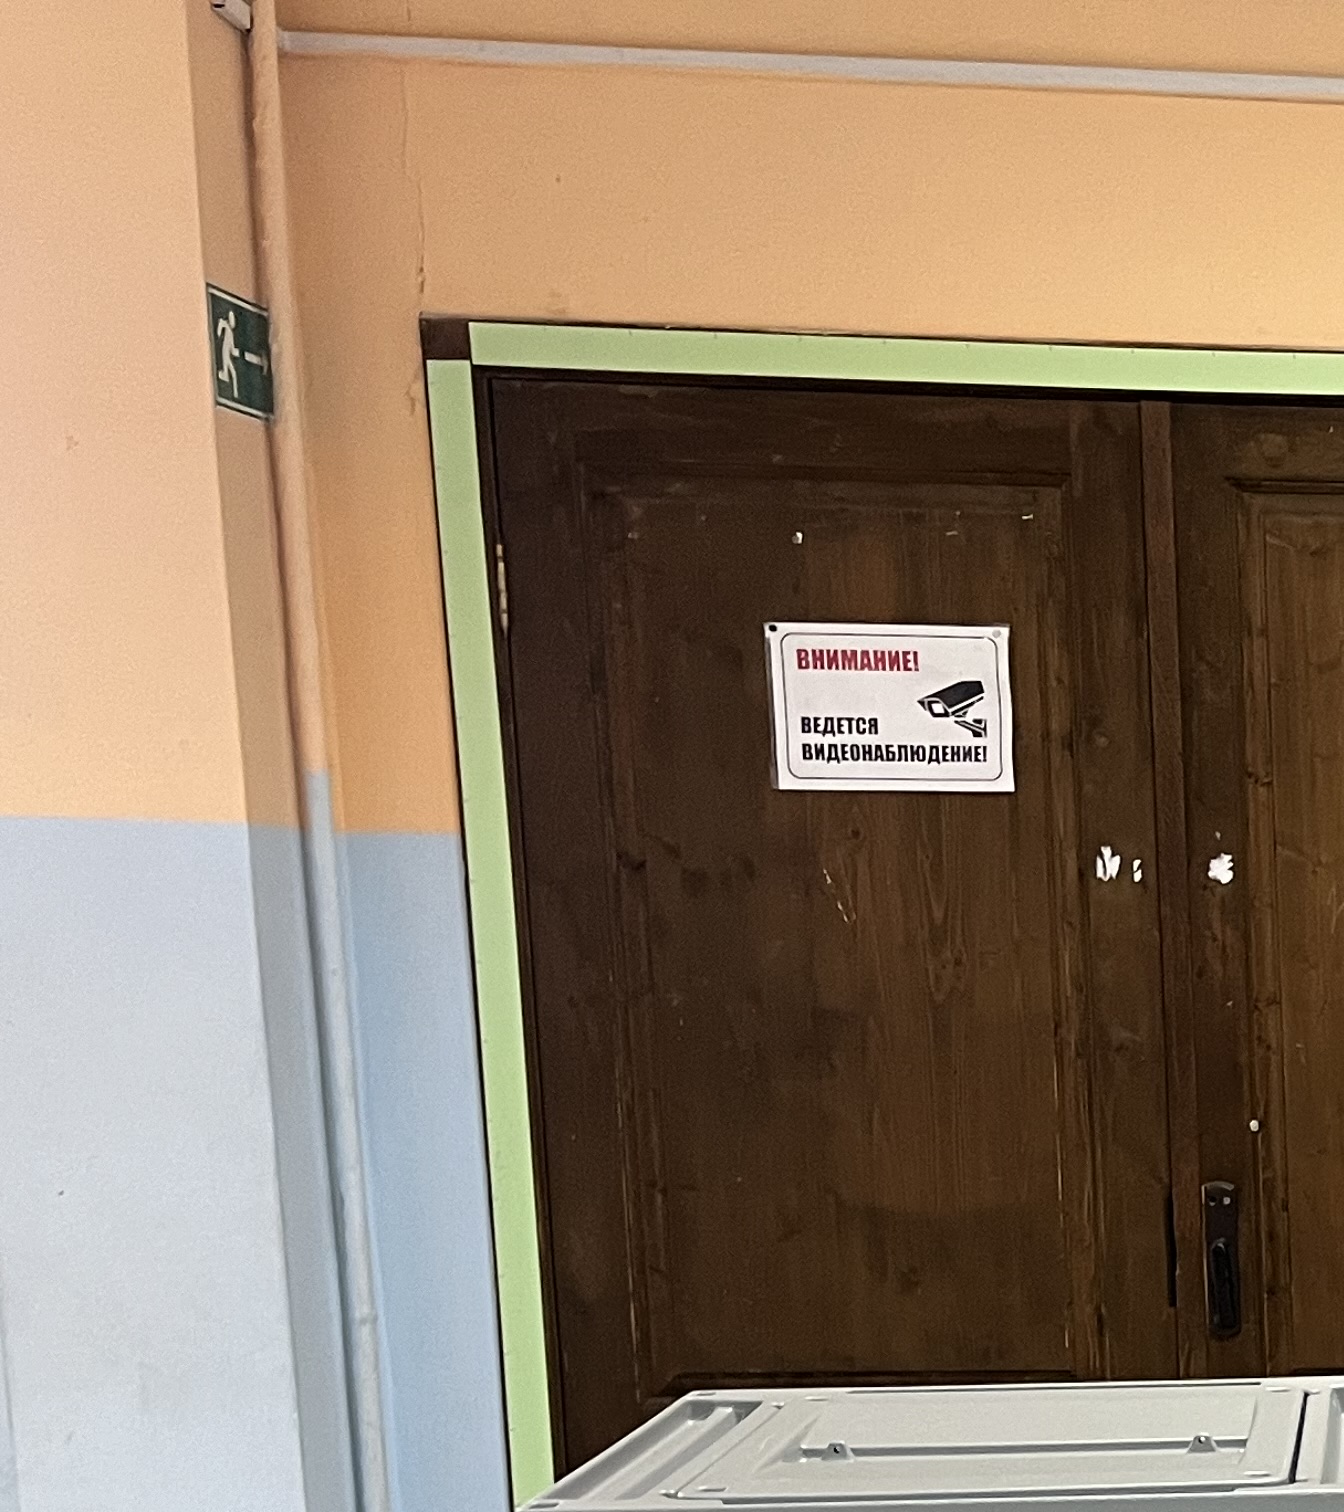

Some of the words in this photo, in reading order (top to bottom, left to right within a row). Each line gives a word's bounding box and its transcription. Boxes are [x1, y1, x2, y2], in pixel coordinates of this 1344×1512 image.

[796, 648, 920, 672] ВНИМАНИЕ!
[800, 716, 879, 737] ВЕДЕТСЯ
[801, 743, 988, 765] ВИДЕОНАБЛЮДЕНИЕ!
